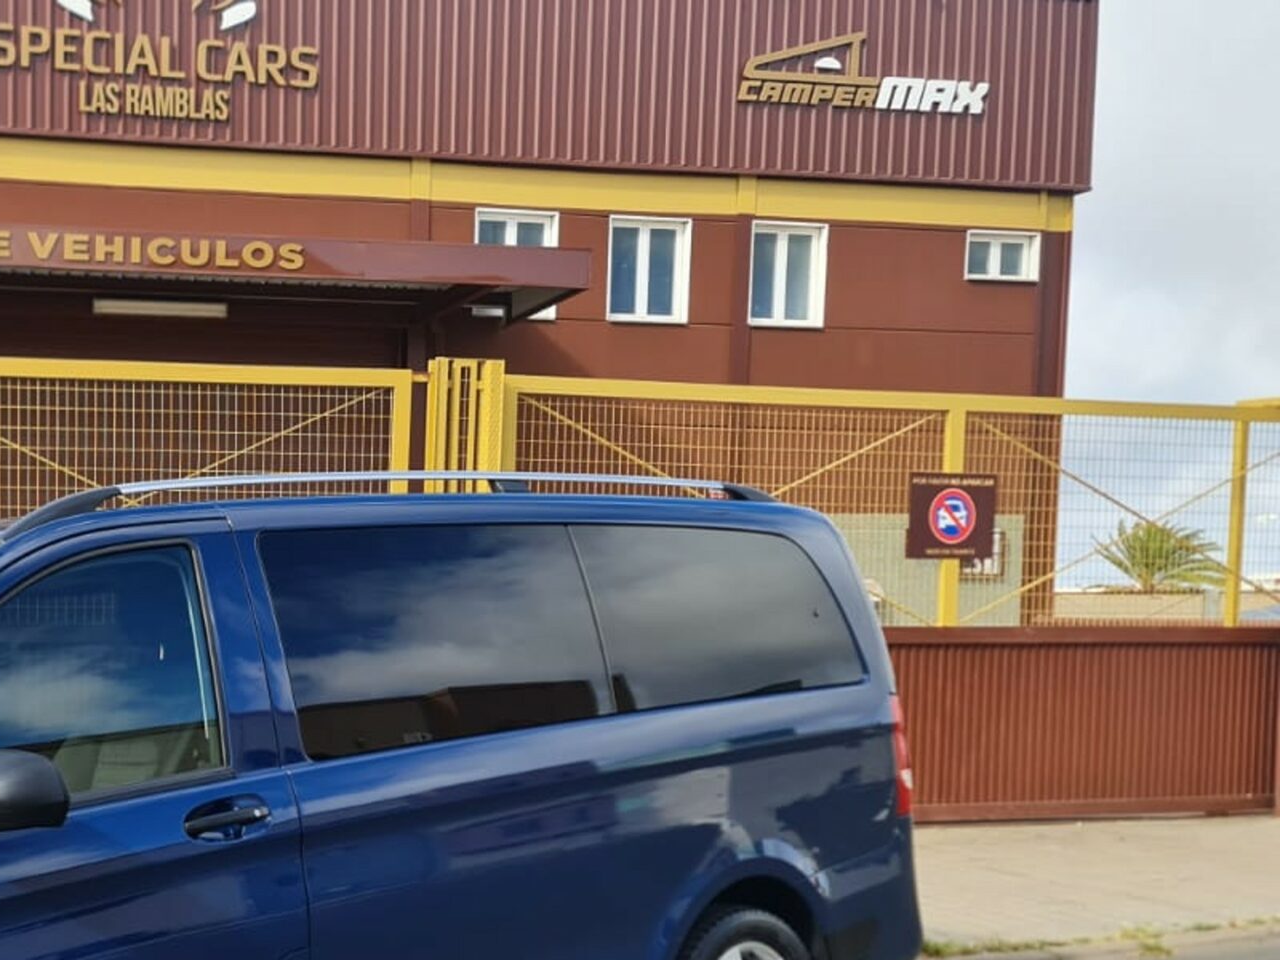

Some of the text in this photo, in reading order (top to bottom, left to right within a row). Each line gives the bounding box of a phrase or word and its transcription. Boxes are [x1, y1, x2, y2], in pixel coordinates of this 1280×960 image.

[196, 38, 320, 89] CARS
[78, 79, 231, 121] LAS RAMBLAS
[27, 231, 306, 271] VEHICULOS
